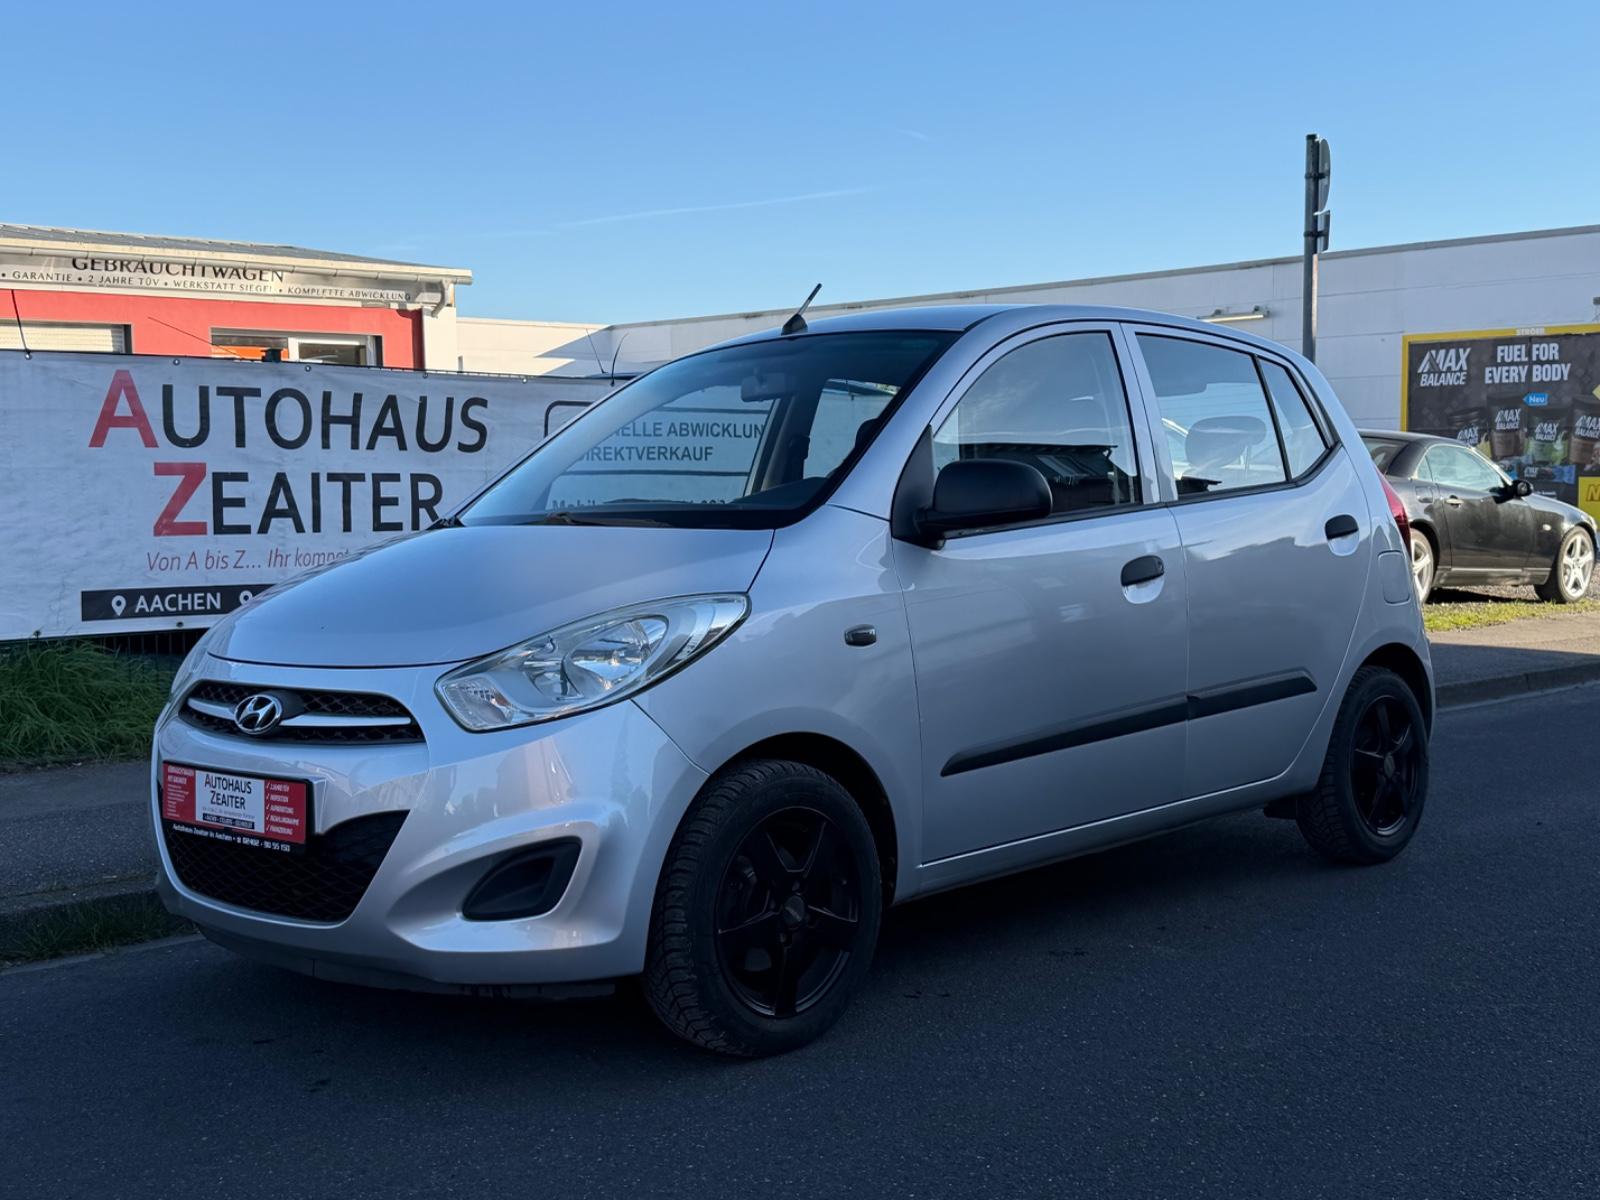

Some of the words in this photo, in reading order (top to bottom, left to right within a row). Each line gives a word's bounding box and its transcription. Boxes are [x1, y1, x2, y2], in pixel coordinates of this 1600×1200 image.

[72, 256, 284, 283] GEBRAUCHTWAGEN
[13, 271, 72, 282] GARANTIE
[88, 275, 95, 283] 2
[99, 276, 134, 285] JAHRE
[138, 276, 160, 287] TÜV
[173, 279, 234, 291] WERKSTATT
[287, 286, 345, 297] KOMPLETTE
[1496, 344, 1528, 363] FUEL
[1532, 343, 1559, 362] FOR
[1420, 371, 1468, 387] BALANCE
[1484, 364, 1529, 384] EVERY
[1532, 363, 1571, 382] BODY
[1528, 395, 1545, 404] Neu
[88, 369, 488, 454] AUTOHAUS
[153, 462, 444, 537] ZEAITER
[147, 551, 181, 571] Von
[185, 551, 199, 570] A
[204, 550, 229, 570] bis
[268, 549, 292, 568] Ihr
[134, 592, 222, 613] AACHEN
[204, 773, 252, 794] AUTOHAUS
[210, 790, 246, 810] ZEAITER
